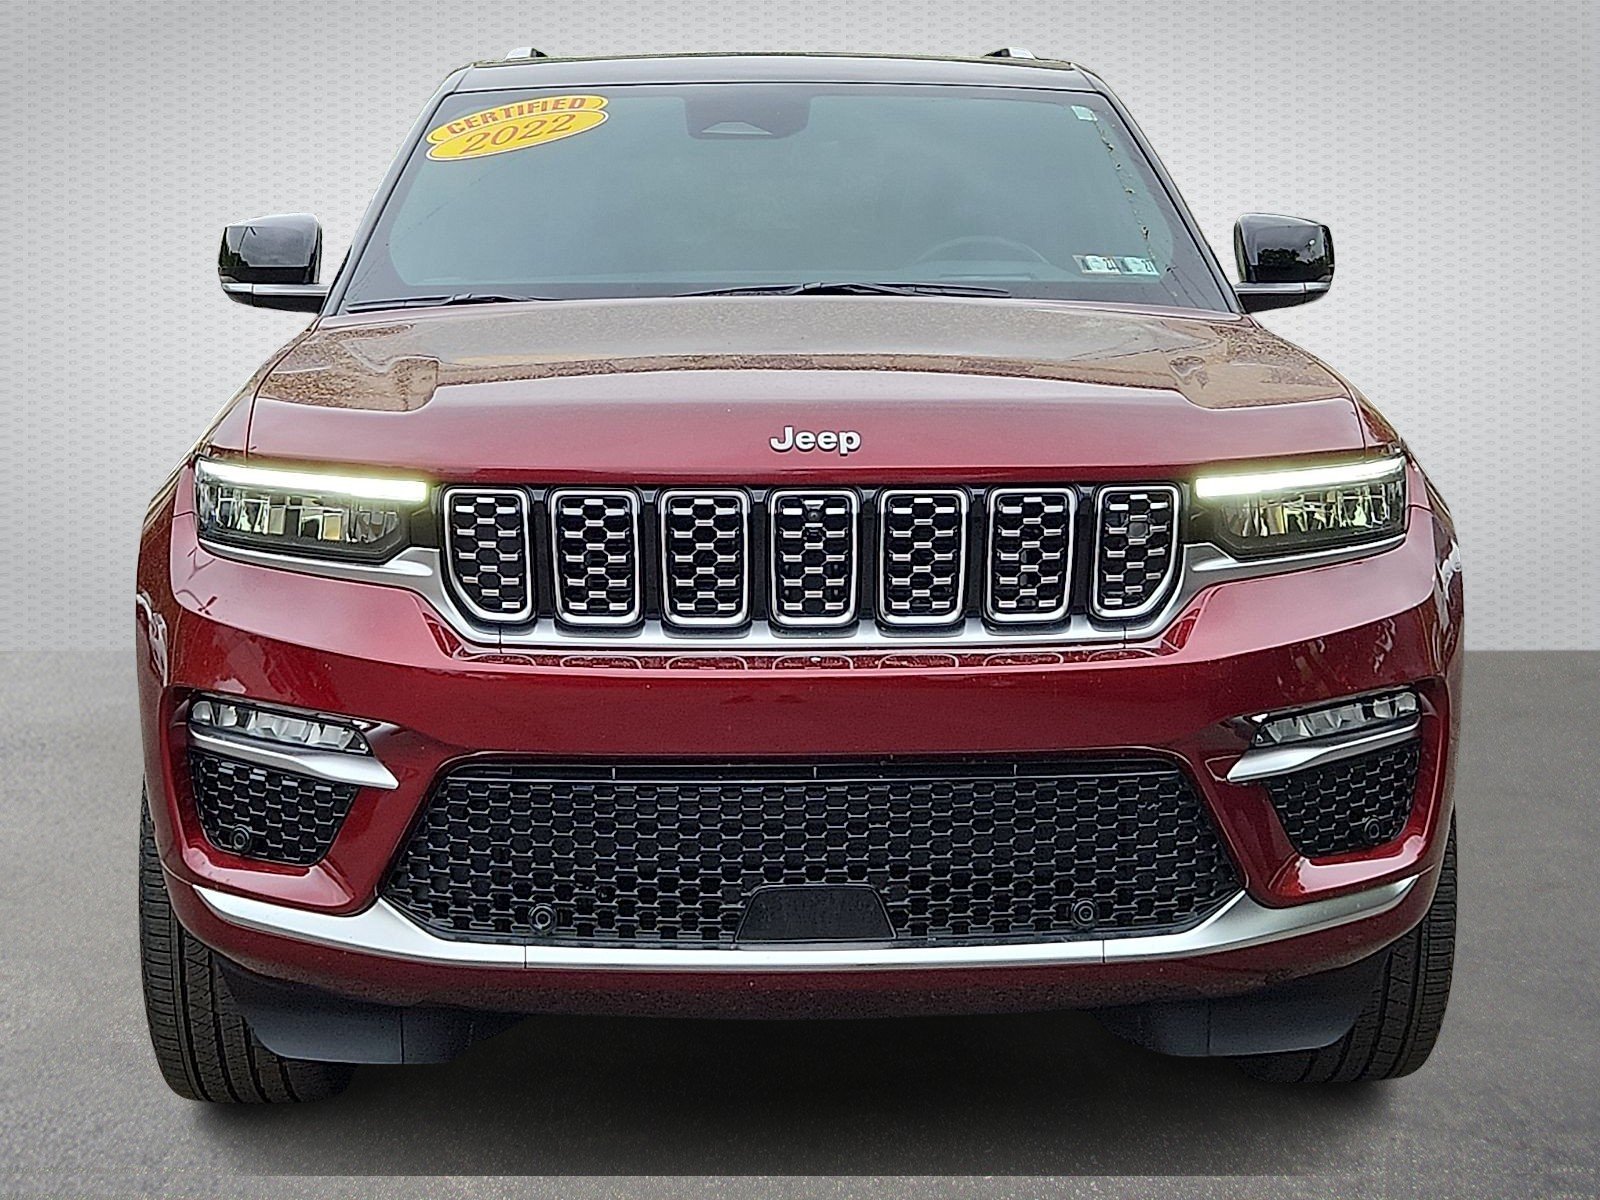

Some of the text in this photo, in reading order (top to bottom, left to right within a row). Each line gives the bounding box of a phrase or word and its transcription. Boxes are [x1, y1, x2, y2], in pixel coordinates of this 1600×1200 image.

[447, 97, 586, 135] CERTIFIED
[459, 114, 576, 155] 2022
[770, 426, 861, 456] Jeep
